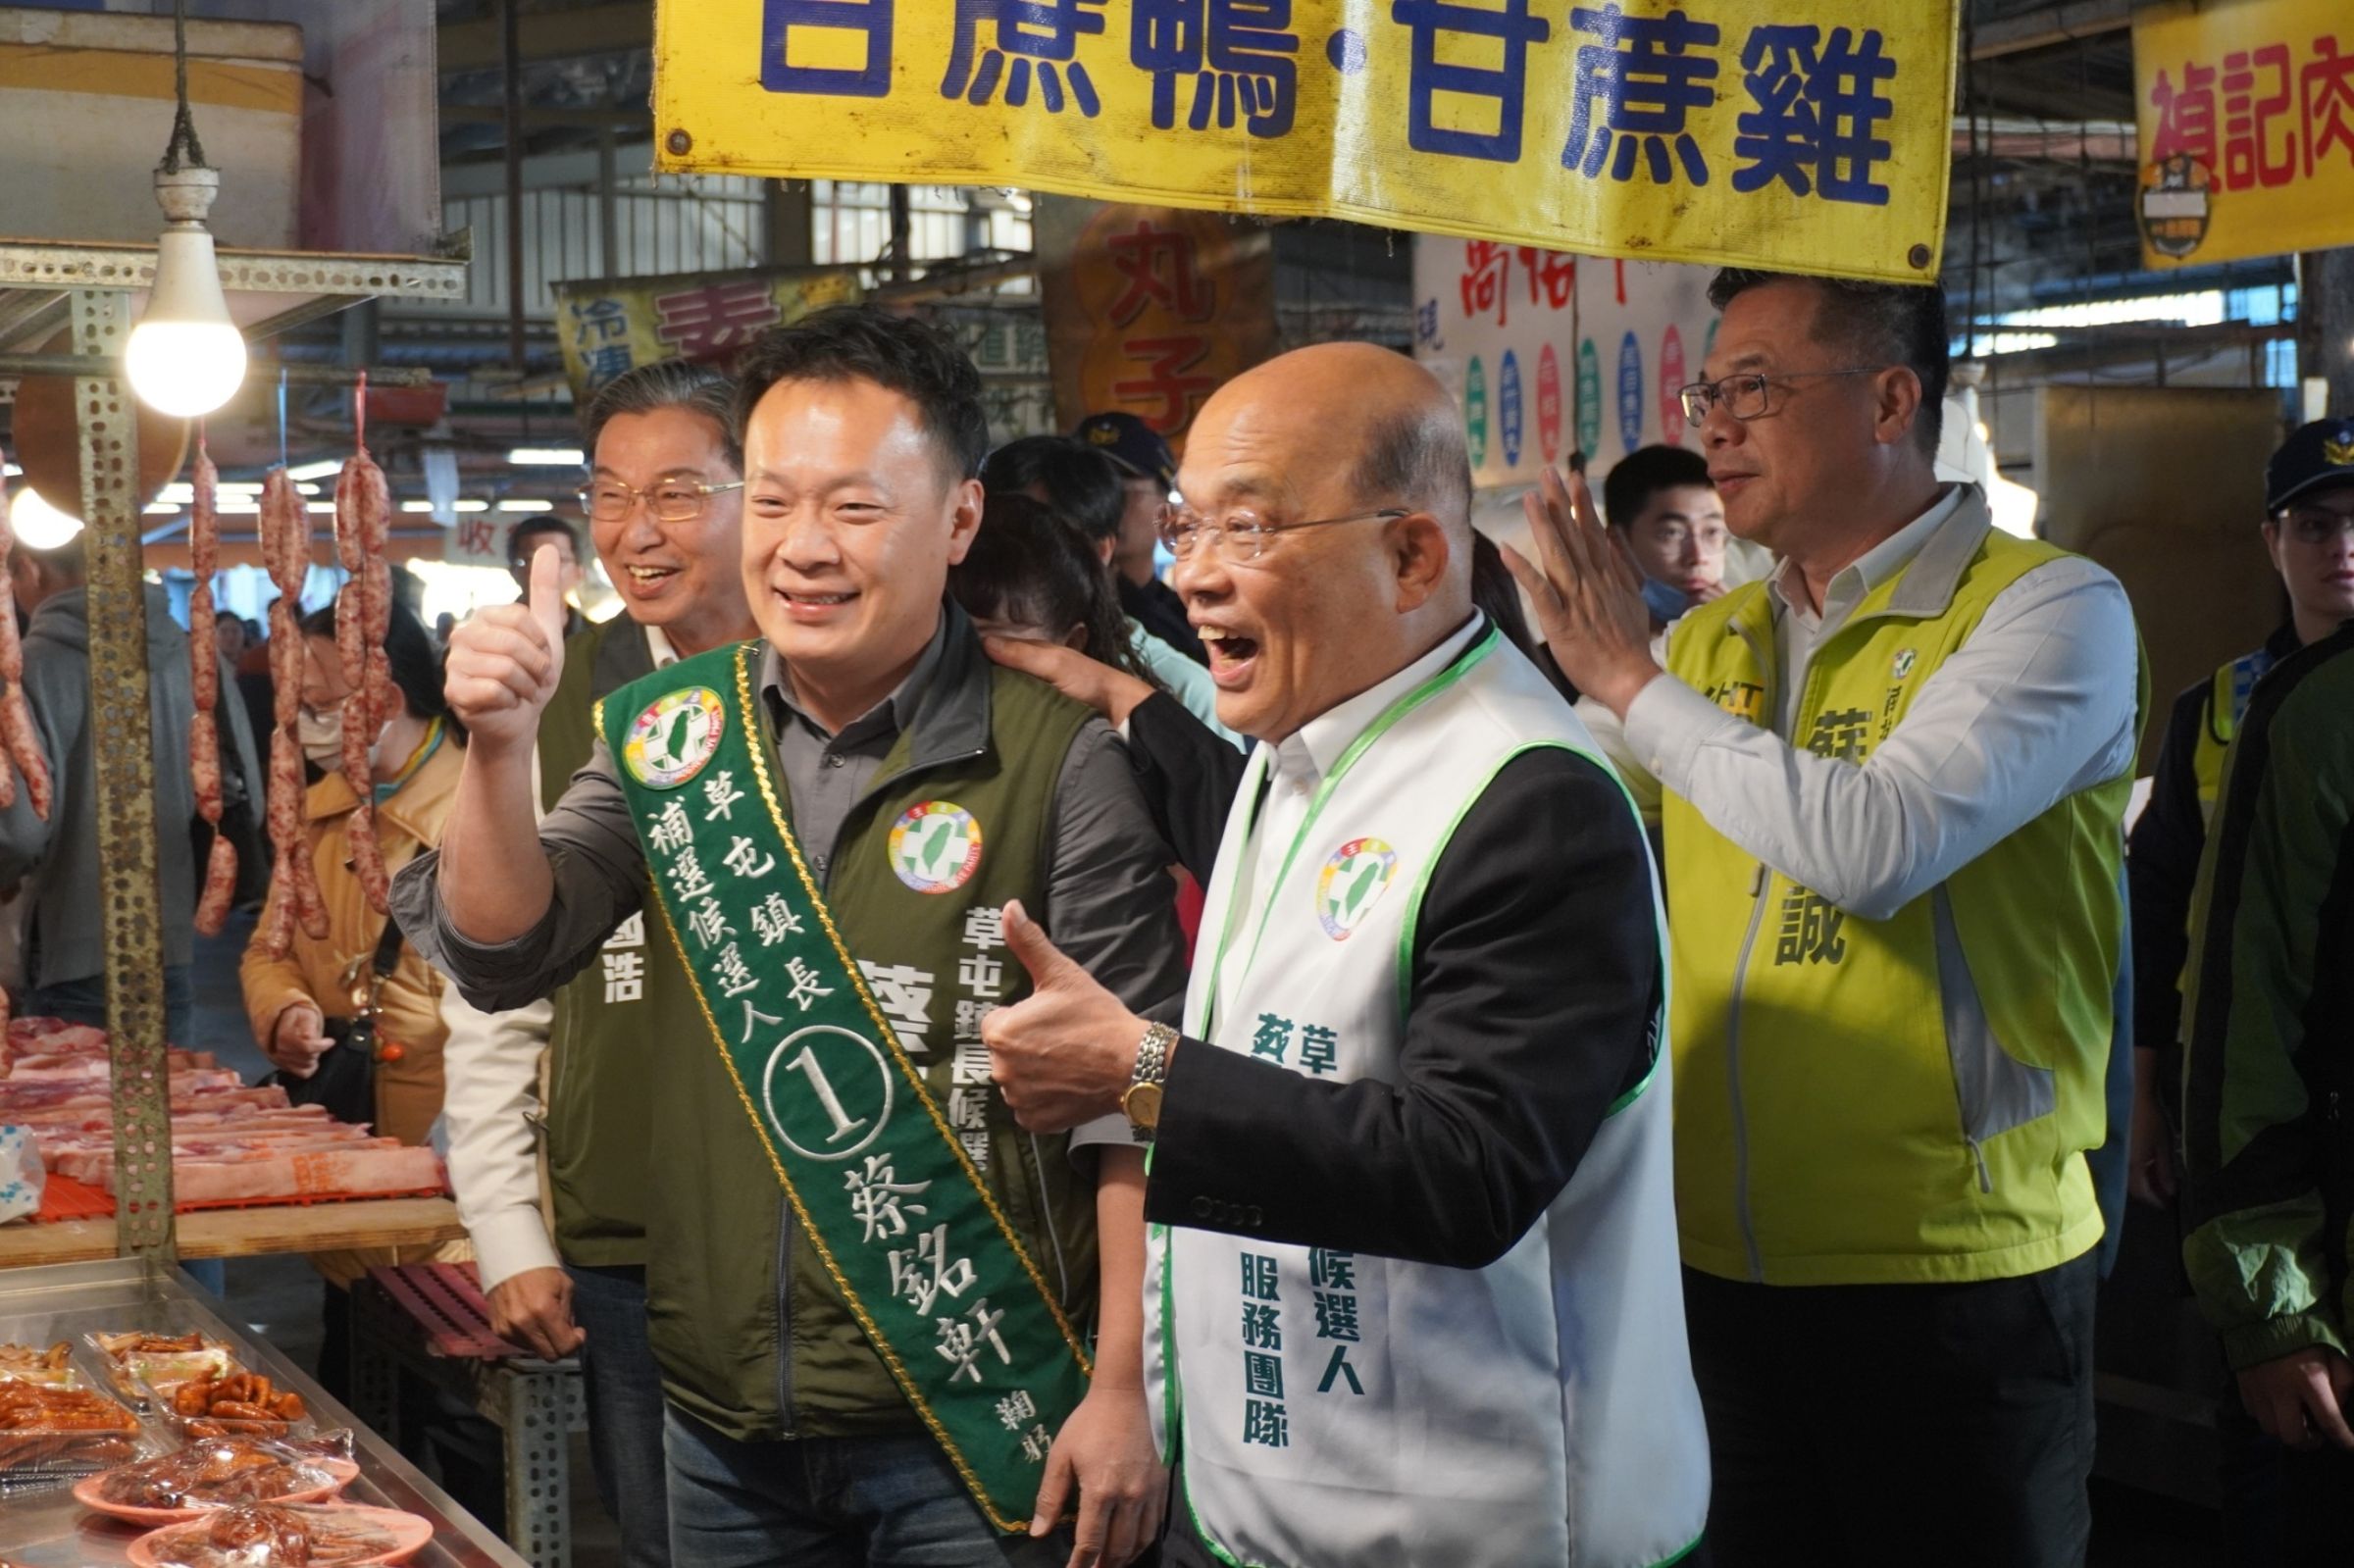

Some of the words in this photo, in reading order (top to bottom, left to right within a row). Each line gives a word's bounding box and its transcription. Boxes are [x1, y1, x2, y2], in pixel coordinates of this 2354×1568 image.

[1107, 220, 1216, 432] 丸子
[647, 795, 784, 1043] 補選候選人
[704, 770, 835, 1012] 草屯鎮長
[1299, 1024, 1338, 1075] 草
[844, 1152, 1012, 1384] 蔡銘軒
[1240, 1251, 1290, 1448] 服務團隊
[1307, 1246, 1365, 1395] 候選人
